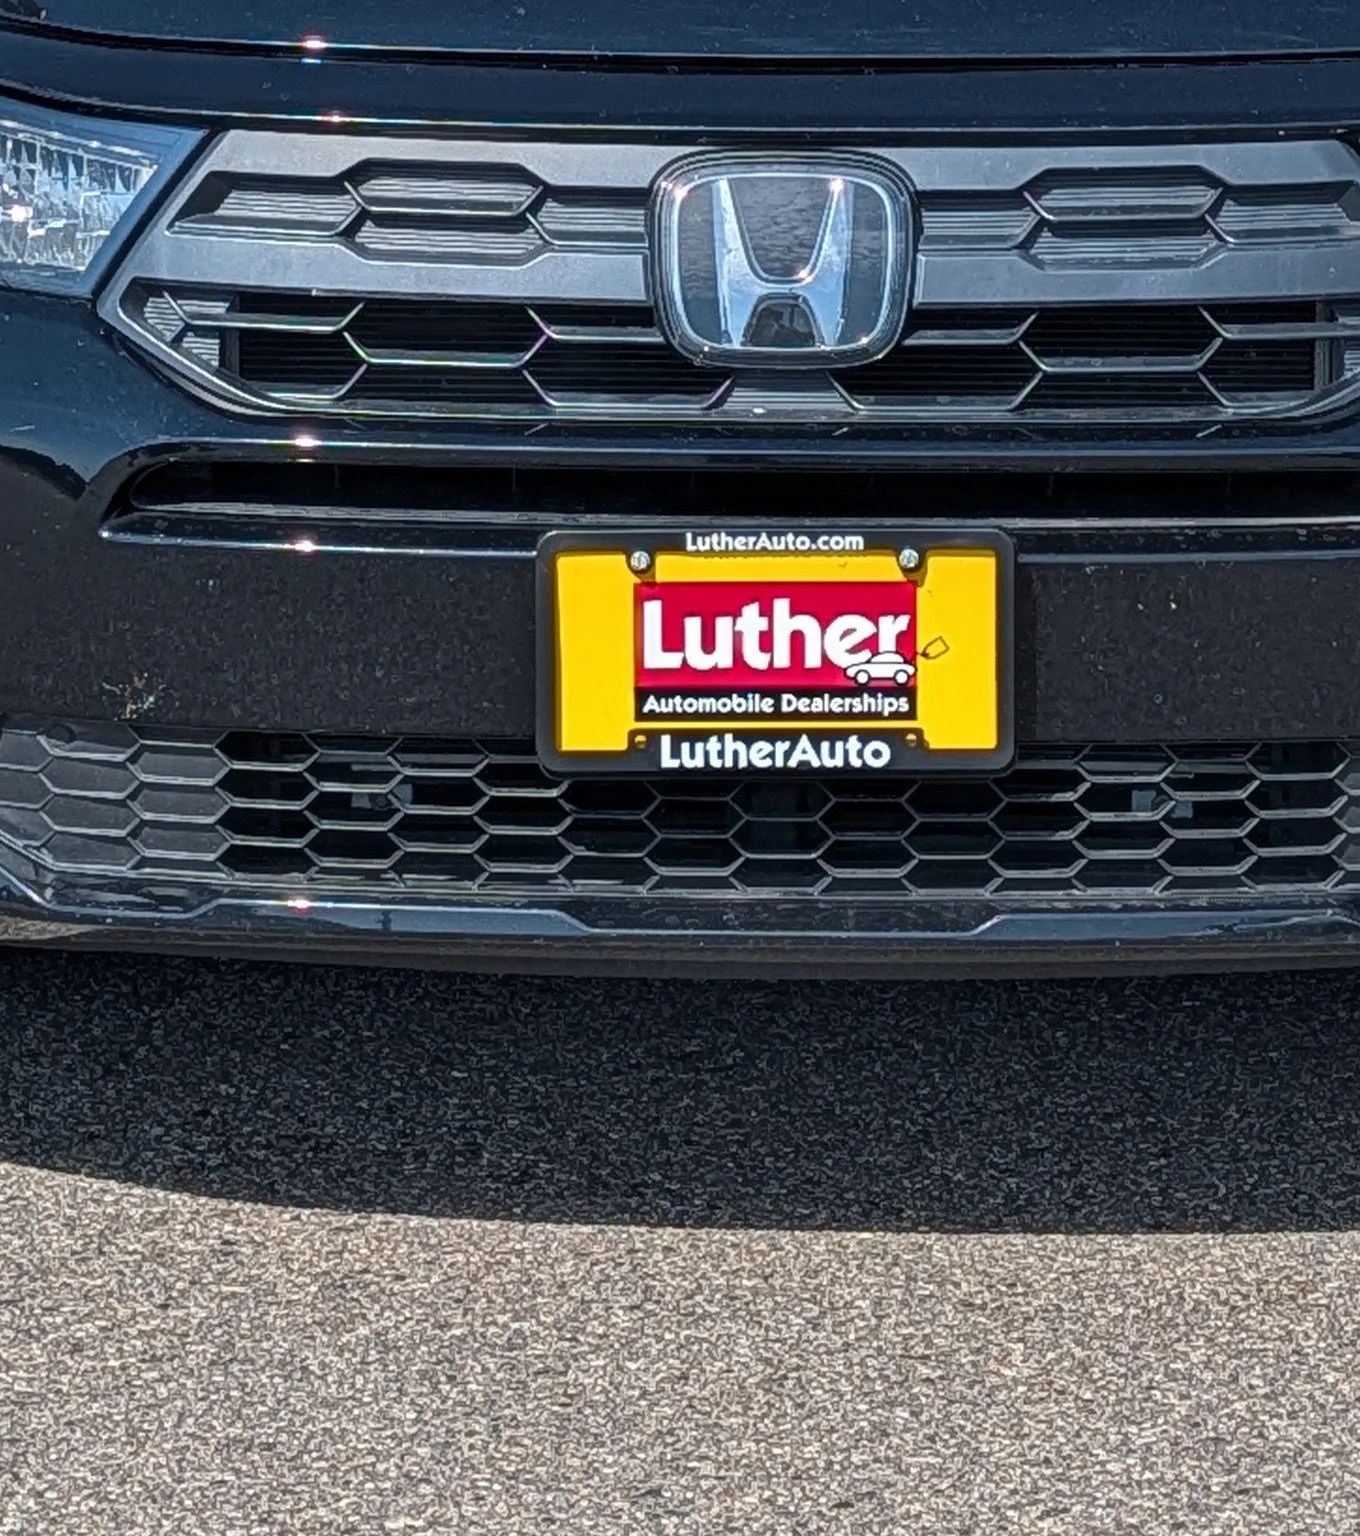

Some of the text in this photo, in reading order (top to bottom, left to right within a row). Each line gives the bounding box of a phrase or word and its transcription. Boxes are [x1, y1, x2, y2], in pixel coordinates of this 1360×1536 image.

[685, 532, 865, 552] LutherAuto.com
[642, 598, 911, 672] Luther
[642, 693, 910, 718] Automobile Dealerships
[659, 733, 892, 770] LutherAuto
